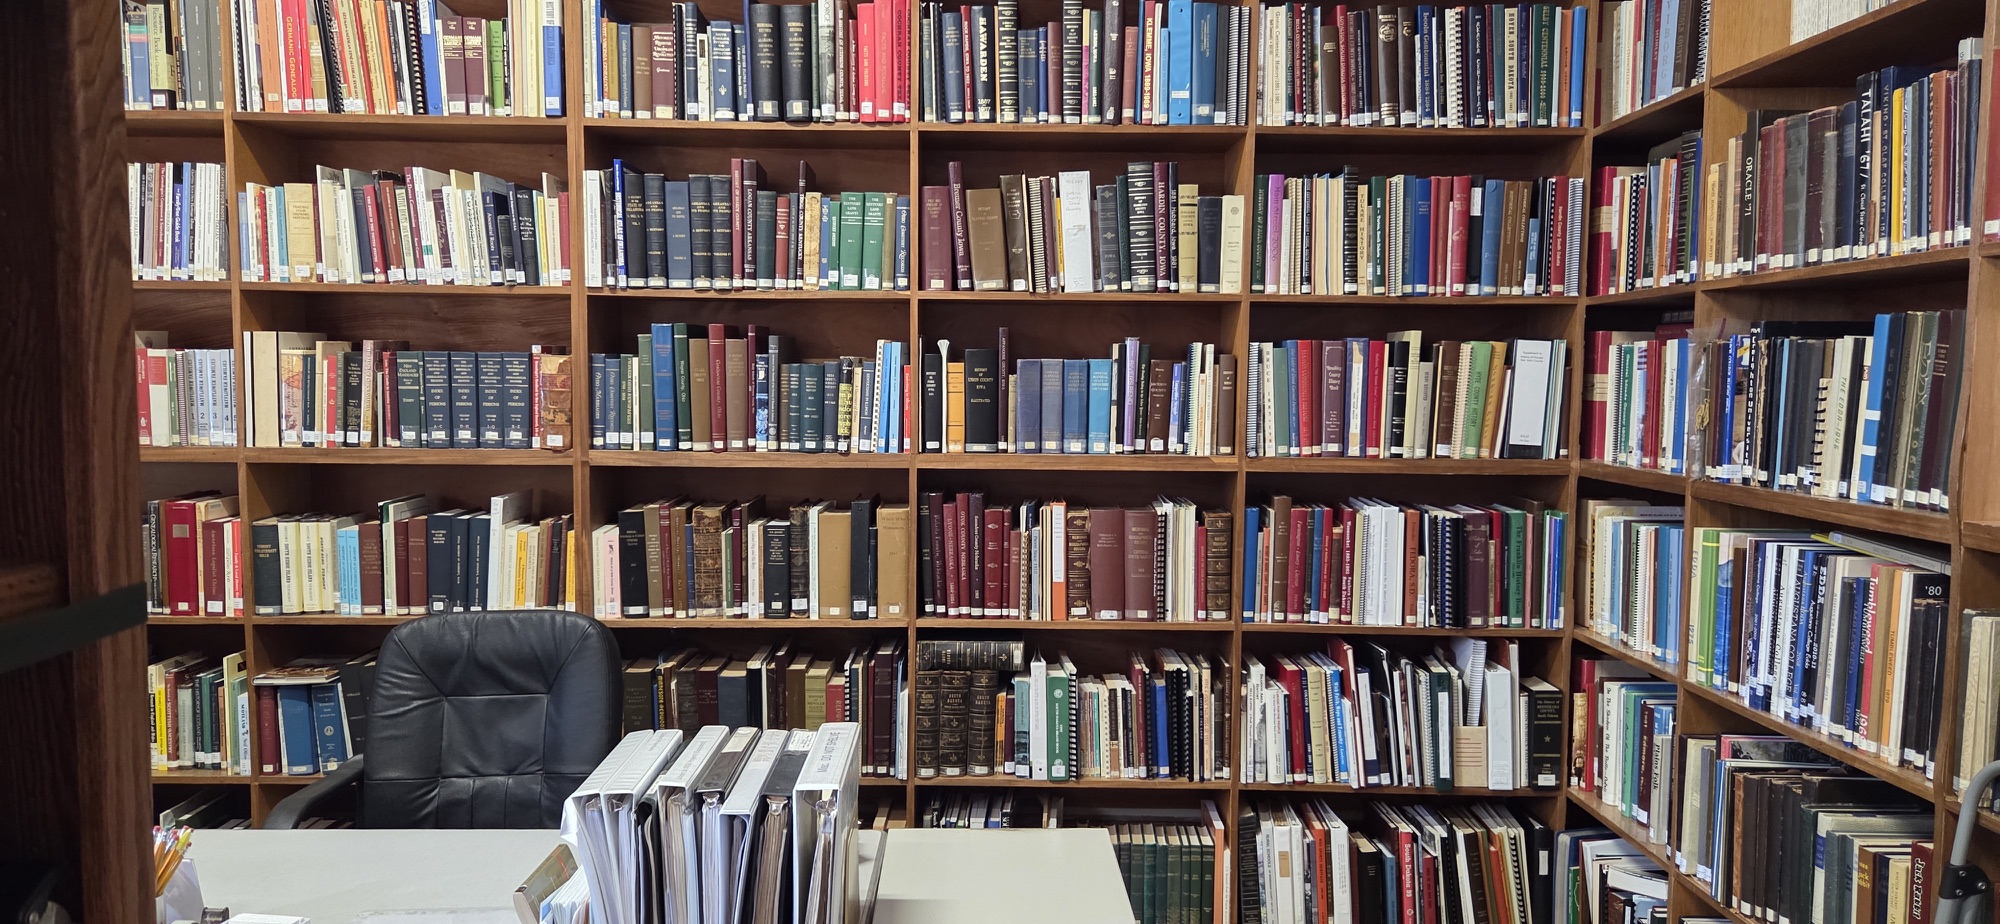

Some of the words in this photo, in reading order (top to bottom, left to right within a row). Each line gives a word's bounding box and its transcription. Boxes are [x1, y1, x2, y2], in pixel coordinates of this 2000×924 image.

[286, 16, 295, 56] GERMANIC
[1145, 18, 1153, 51] KLEMME,
[979, 17, 987, 81] HAWARDEN
[1860, 89, 1871, 142] TALAHI
[1859, 150, 1870, 168] '67
[1744, 157, 1753, 201] ORACLE
[954, 183, 962, 209] Bremer
[1158, 182, 1166, 213] HARDIN
[1273, 186, 1281, 205] Main
[1744, 203, 1752, 216] '71
[487, 213, 495, 236] Ancestral
[955, 211, 963, 237] County
[1839, 377, 1847, 393] THE
[1471, 408, 1479, 427] HISTORY
[1816, 565, 1827, 604] EDDA
[1926, 586, 1942, 595] '80
[1788, 579, 1801, 643] AUGUSTANA
[1863, 576, 1879, 654] Tumbleweed
[1886, 630, 1895, 676] TUMBLEWEED
[1785, 646, 1796, 692] COLLEGE
[1652, 744, 1661, 770] Plains
[1652, 772, 1660, 790] Folk
[1914, 858, 1924, 882] Jack
[1912, 884, 1923, 920] Rabbit
